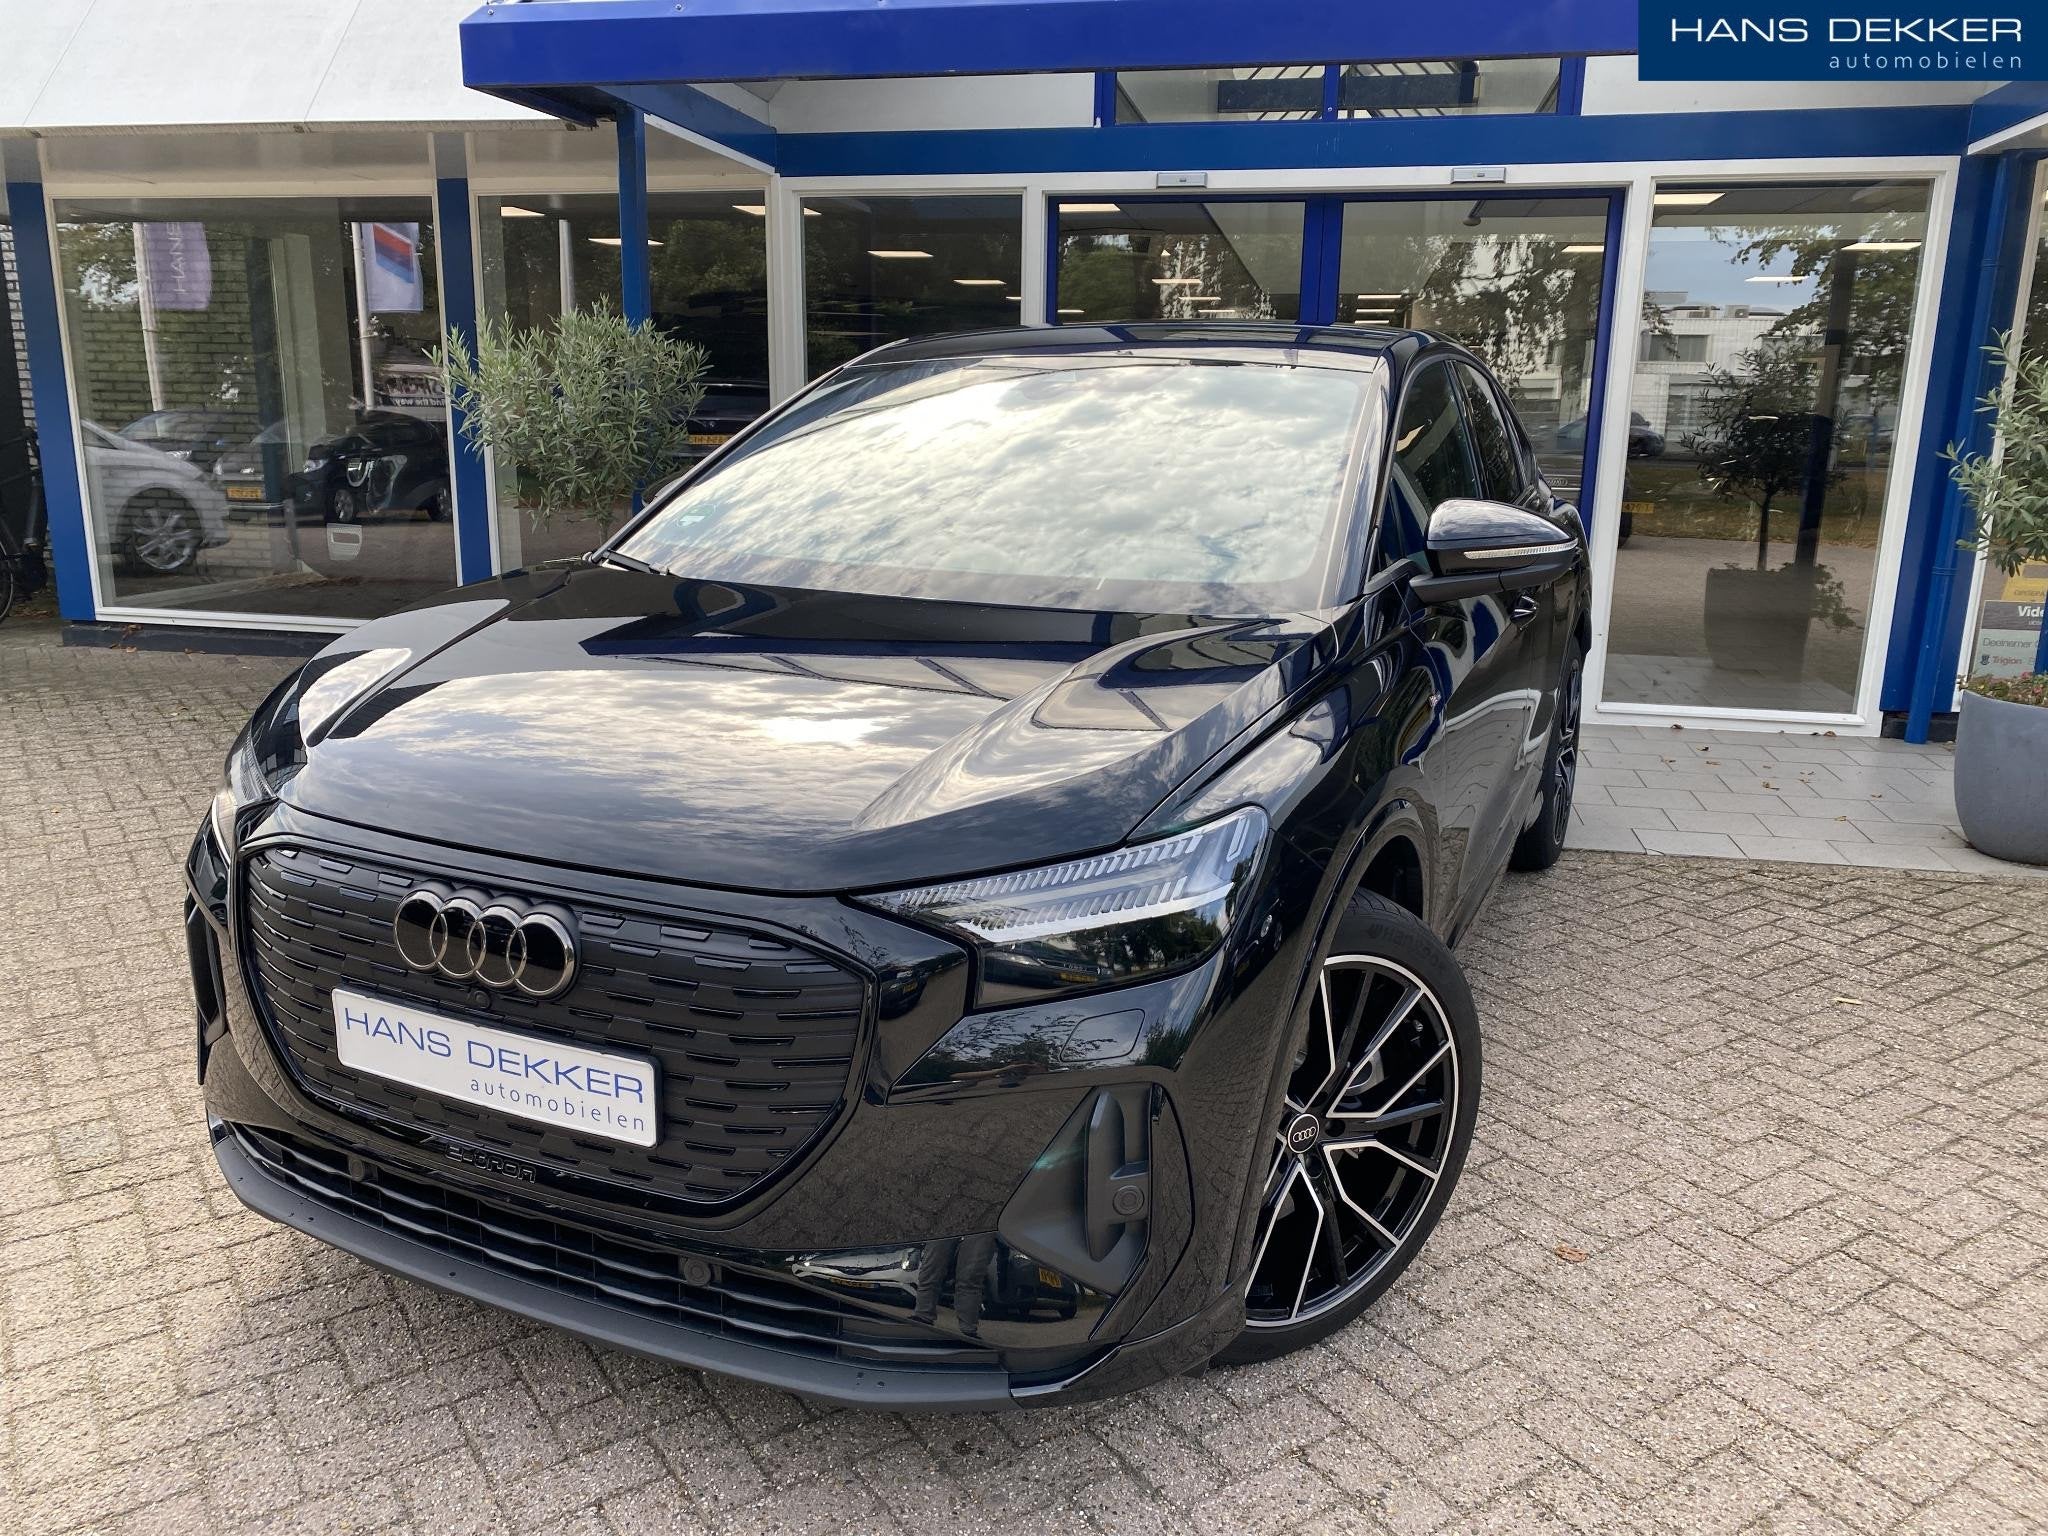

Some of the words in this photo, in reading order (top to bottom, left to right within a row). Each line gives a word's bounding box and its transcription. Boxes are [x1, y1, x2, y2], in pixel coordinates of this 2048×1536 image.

[344, 1007, 451, 1058] HANS
[467, 1039, 644, 1104] DEKKER
[470, 1077, 644, 1132] automobielen
